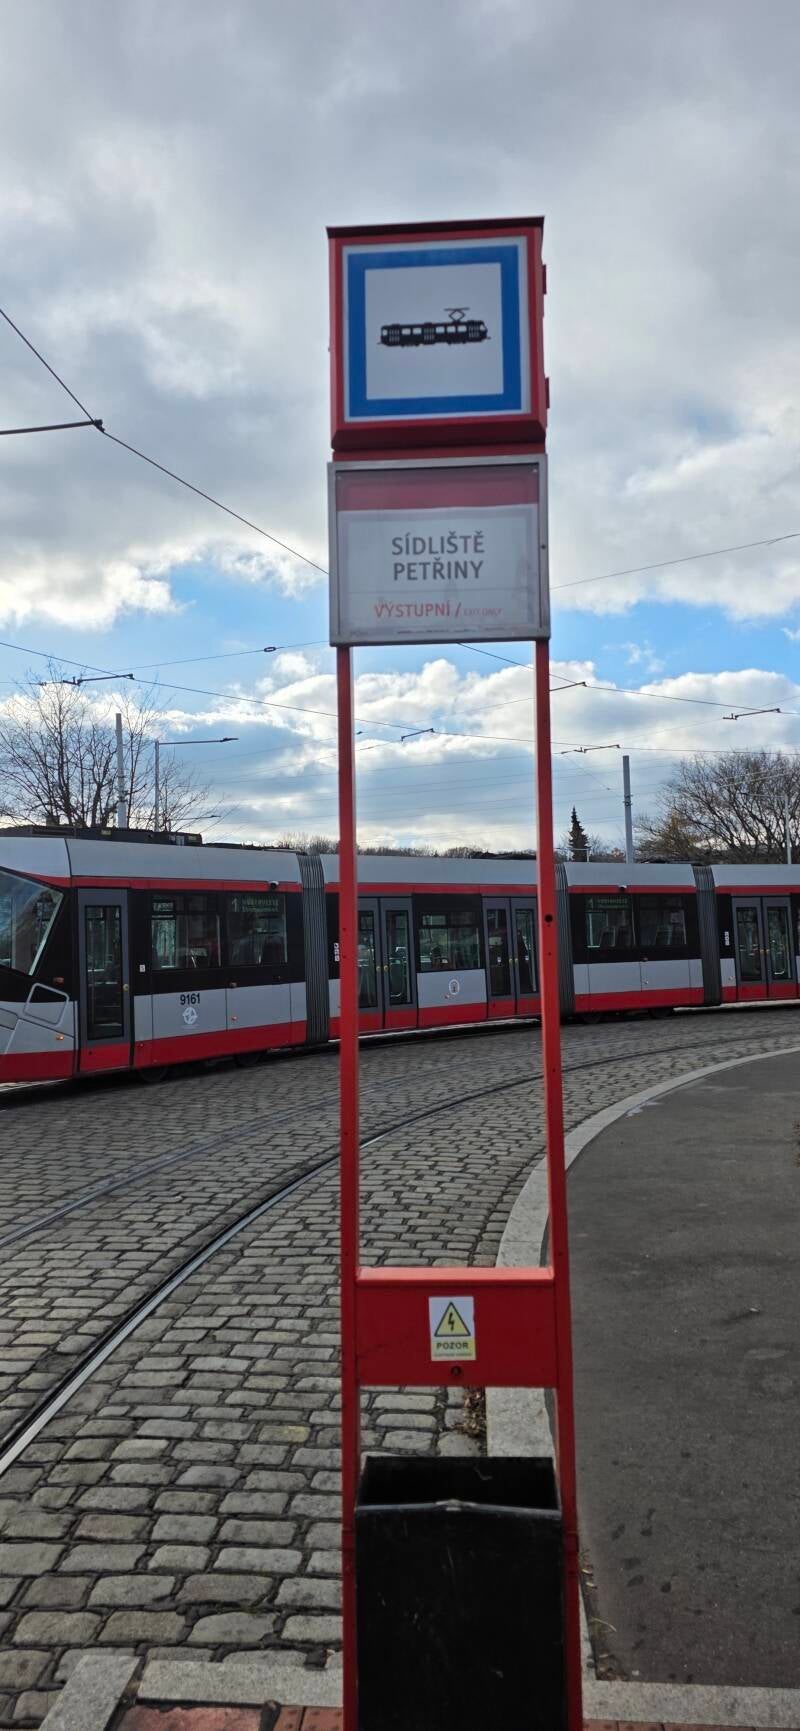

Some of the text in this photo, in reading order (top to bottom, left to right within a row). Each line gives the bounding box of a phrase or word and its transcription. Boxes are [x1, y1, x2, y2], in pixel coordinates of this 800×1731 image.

[391, 530, 485, 555] SÍDLIŠTĚ
[393, 557, 484, 581] PETŘINY
[374, 601, 450, 618] VÝSTUPNÍ
[180, 993, 201, 1006] 9161
[436, 1342, 469, 1350] POZOR
